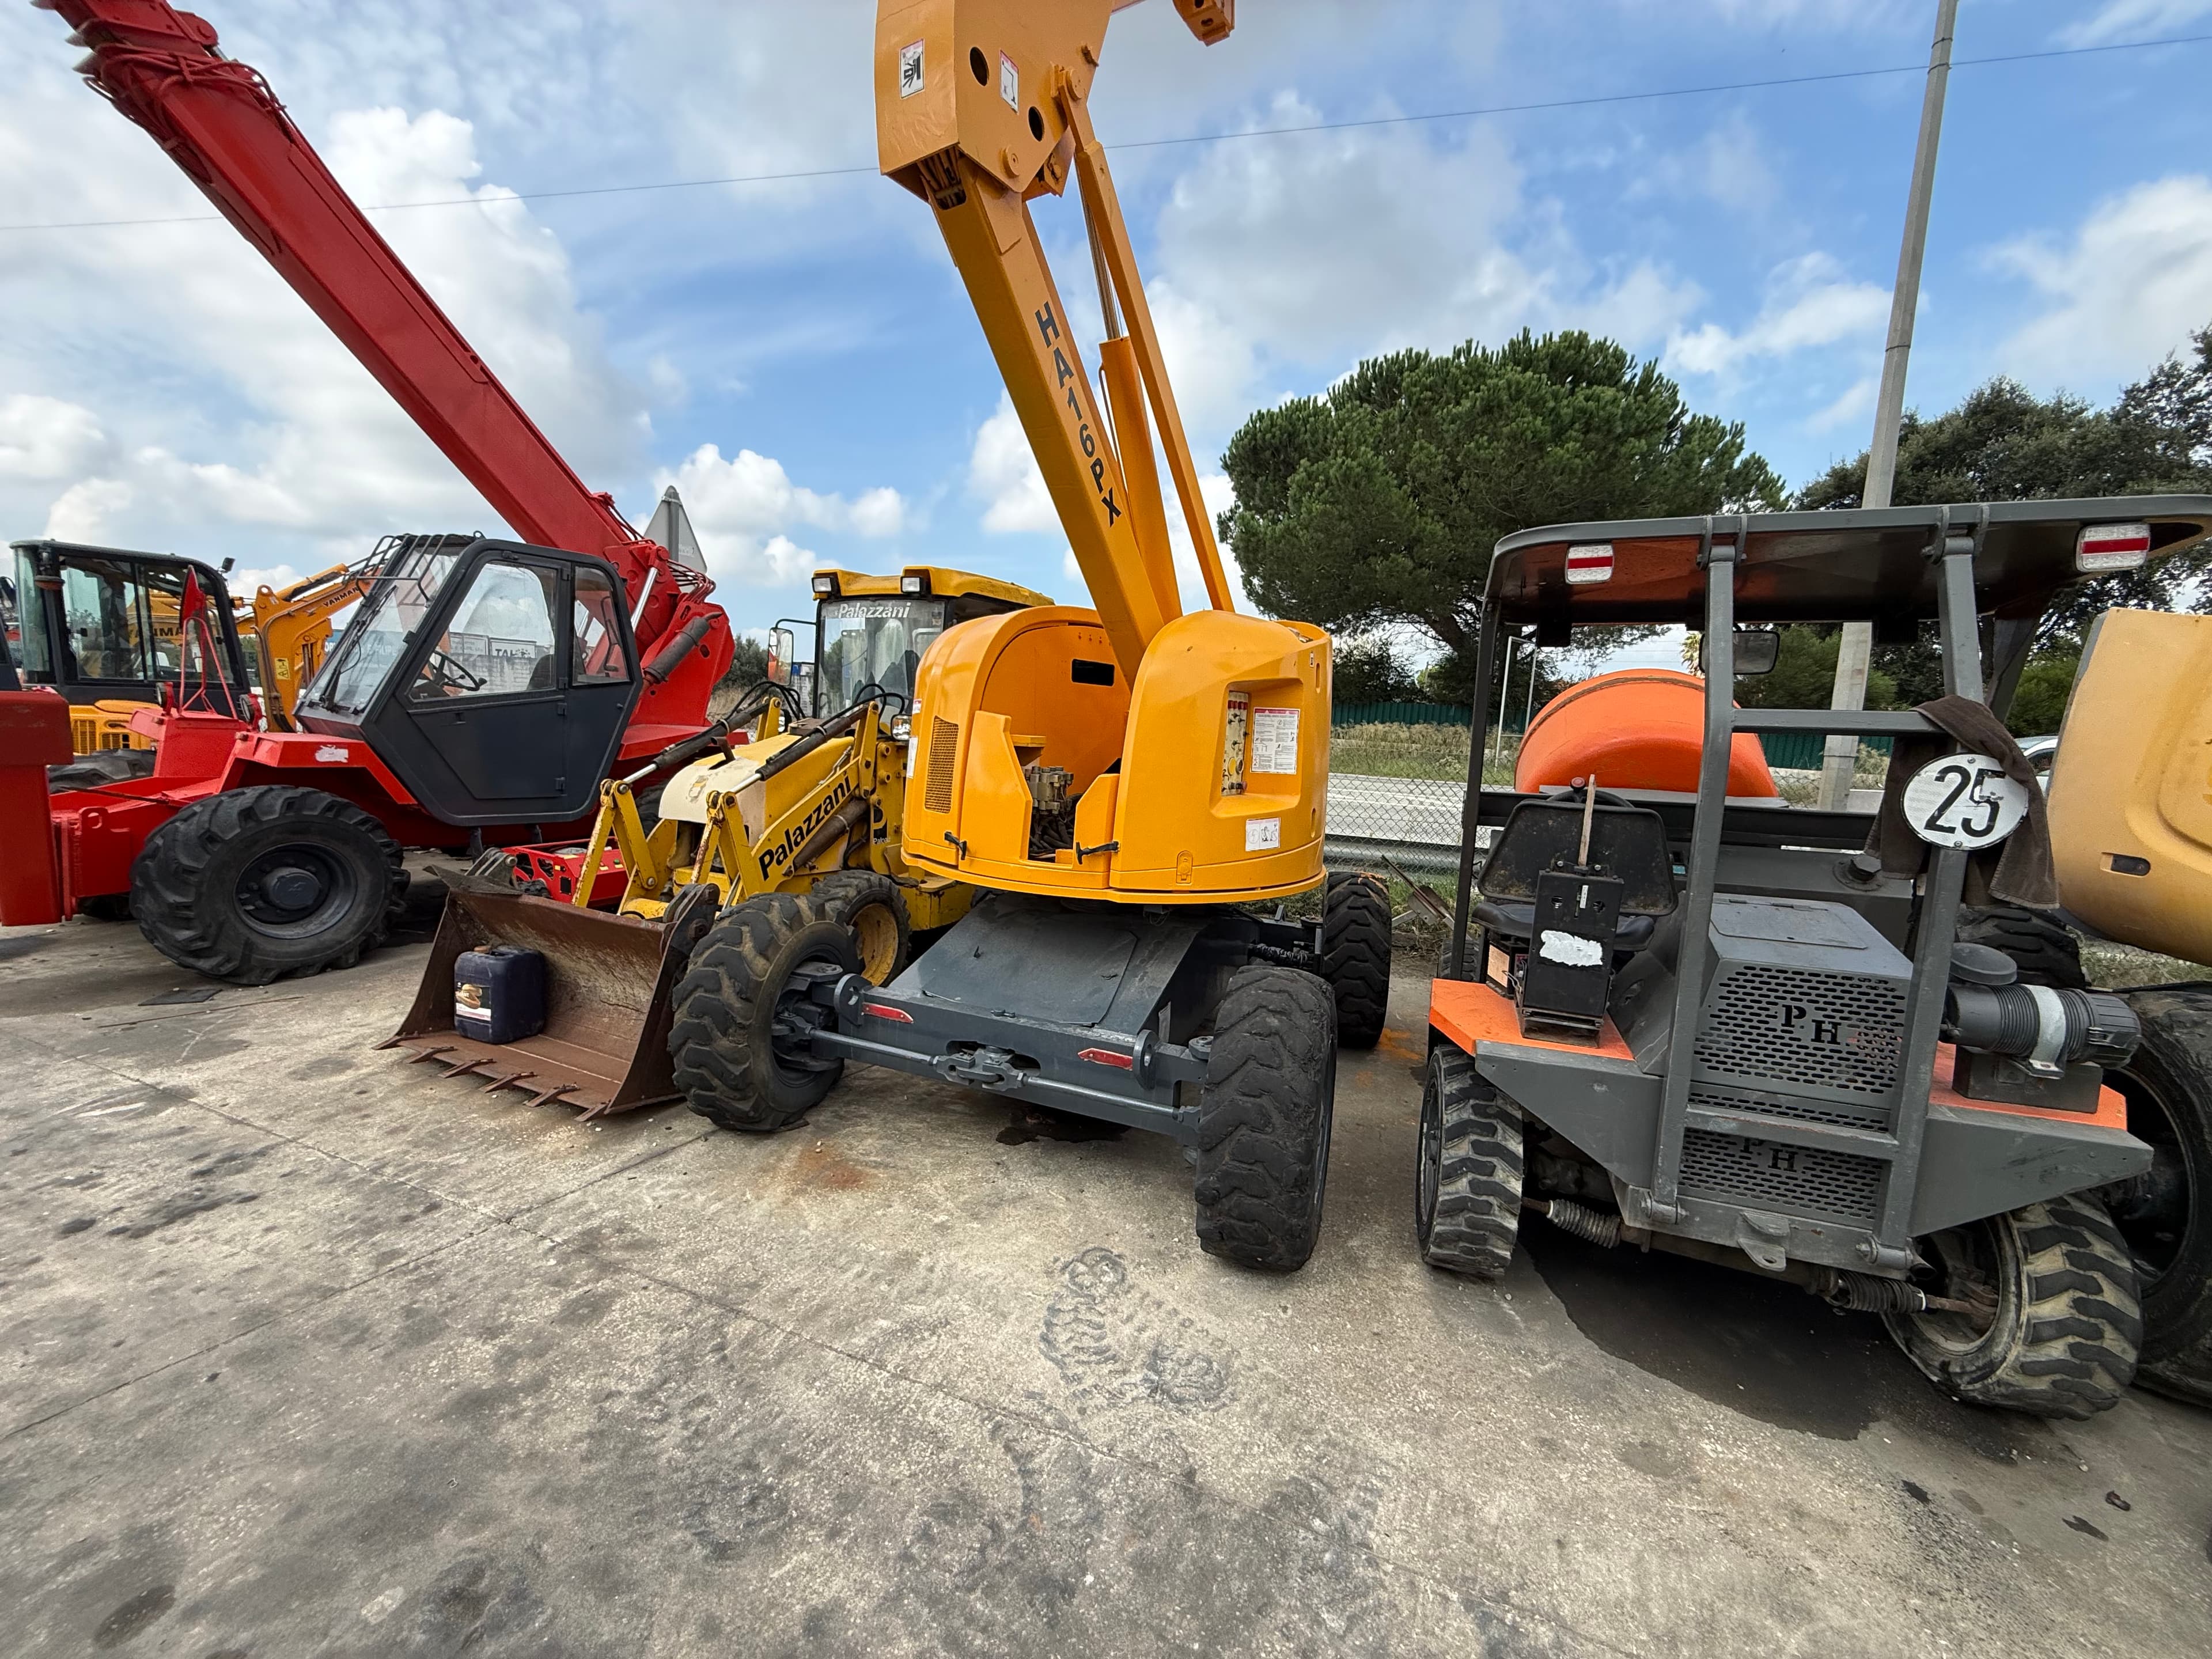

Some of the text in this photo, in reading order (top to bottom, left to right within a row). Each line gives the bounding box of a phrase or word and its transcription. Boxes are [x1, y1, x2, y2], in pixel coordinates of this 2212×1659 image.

[1035, 301, 1122, 528] HA16PX
[838, 602, 911, 619] Palazzani
[758, 775, 851, 881] Palazzani
[1924, 764, 2007, 838] 25
